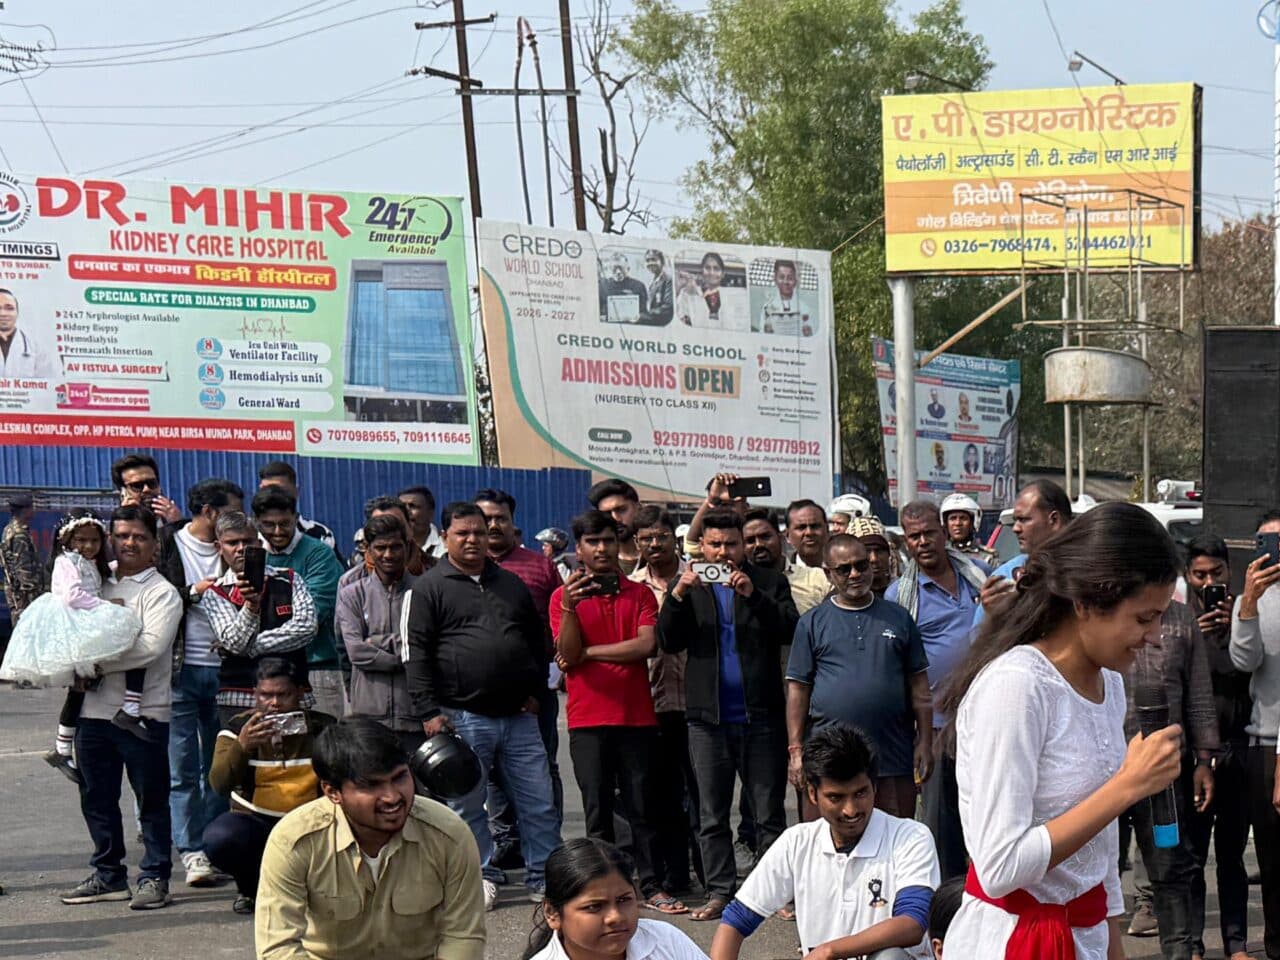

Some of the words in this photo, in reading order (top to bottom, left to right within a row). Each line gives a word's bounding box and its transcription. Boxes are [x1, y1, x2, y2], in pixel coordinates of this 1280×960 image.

[35, 177, 147, 227] DR.
[170, 186, 352, 239] MIHIR
[109, 229, 180, 256] KIDNEY
[186, 233, 235, 258] CARE
[239, 236, 329, 262] HOSPITAL
[368, 231, 440, 246] Emergency
[502, 234, 583, 260] CREDO
[387, 245, 437, 256] Available
[195, 264, 252, 283] किडनी
[504, 257, 541, 276] WORLD
[544, 261, 584, 280] SCHOOL
[91, 290, 137, 303] SPECIAL
[140, 291, 168, 305] RATE
[171, 292, 193, 305] FOR
[195, 294, 243, 307] DIALYSIS
[246, 297, 258, 308] IN
[260, 298, 310, 310] DHANBAD
[516, 307, 542, 319] 2026
[551, 310, 576, 321] 2027
[229, 349, 279, 362] Ventilator
[282, 351, 319, 365] Facility
[557, 334, 614, 349] CREDO
[619, 338, 678, 355] WORLD
[682, 343, 747, 361] SCHOOL
[121, 364, 163, 375] SURGERY
[229, 370, 298, 385] Hemodialysis
[301, 372, 323, 384] unit
[561, 357, 677, 390] ADMISSIONS
[684, 366, 734, 394] OPEN
[238, 396, 276, 409] General
[276, 397, 300, 409] Ward
[594, 393, 647, 407] (NURSERY
[649, 397, 663, 408] TO
[666, 398, 699, 410] CLASS
[0, 422, 32, 434] LESWAR
[159, 427, 180, 438] NEAR
[257, 430, 293, 441] DHANBAD
[653, 430, 735, 451] 9297779908
[747, 436, 821, 456] 9297779912
